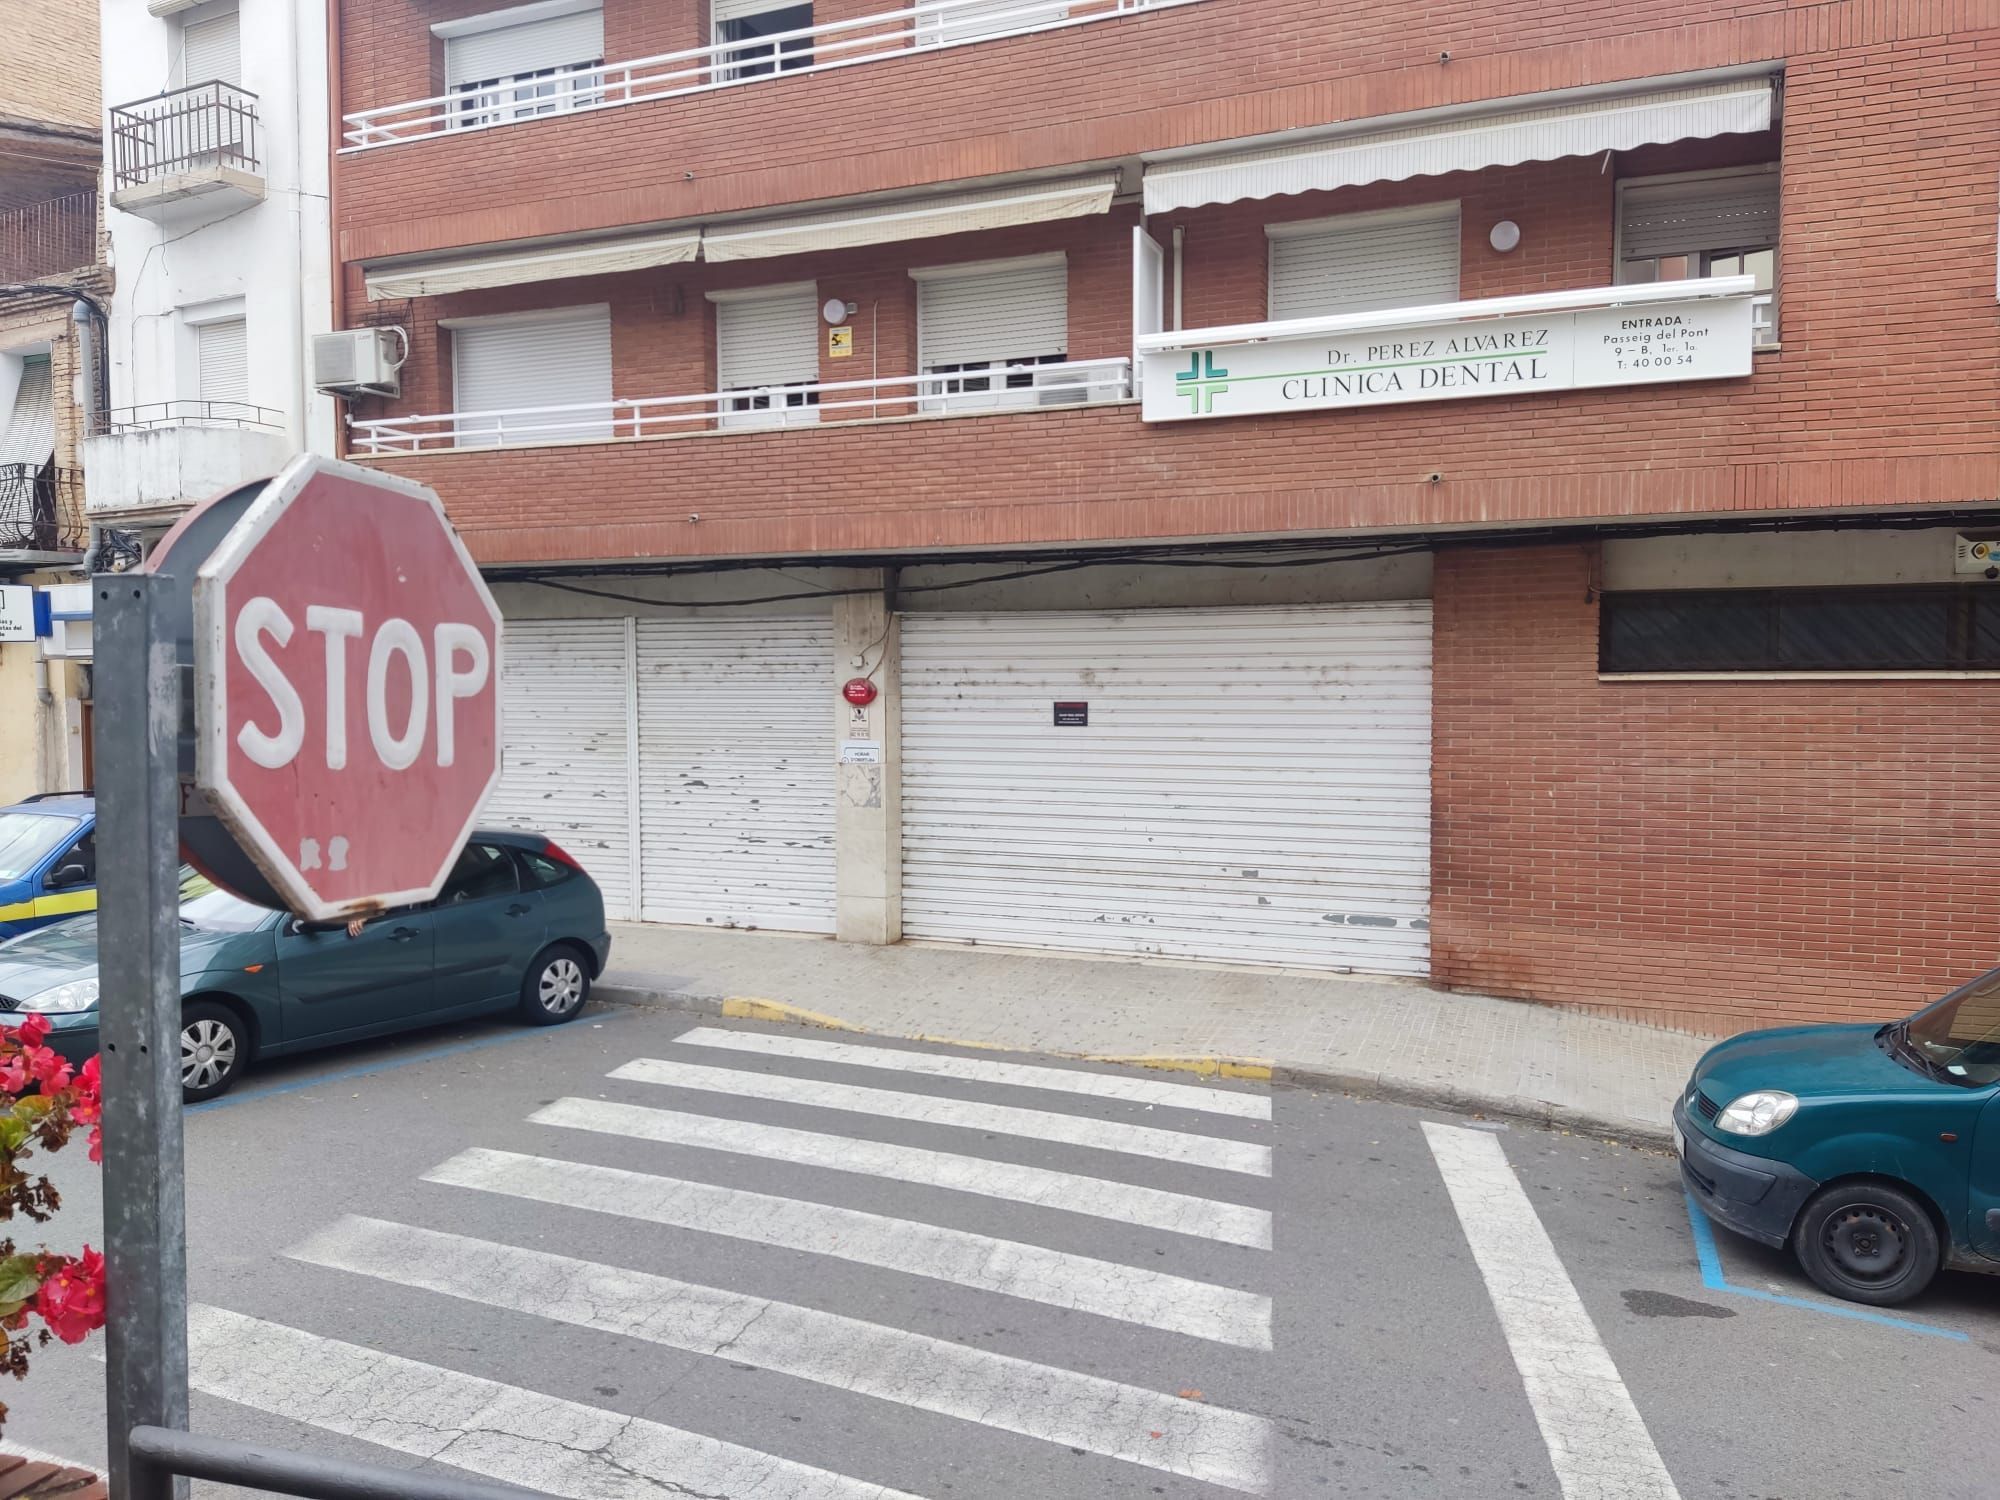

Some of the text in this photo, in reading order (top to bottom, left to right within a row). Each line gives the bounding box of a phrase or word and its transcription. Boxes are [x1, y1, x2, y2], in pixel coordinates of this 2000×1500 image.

[1621, 316, 1682, 329] ENTRADA
[1603, 328, 1709, 344] Passeig del Pont
[1328, 329, 1549, 365] Dr. PEREZ ALVAREZ
[1614, 347, 1622, 356] 9
[1632, 359, 1649, 368] 40
[1654, 356, 1672, 366] 00
[1676, 354, 1692, 365] 54
[1282, 358, 1547, 400] CLINICA DENTAL
[235, 596, 489, 770] STOP
